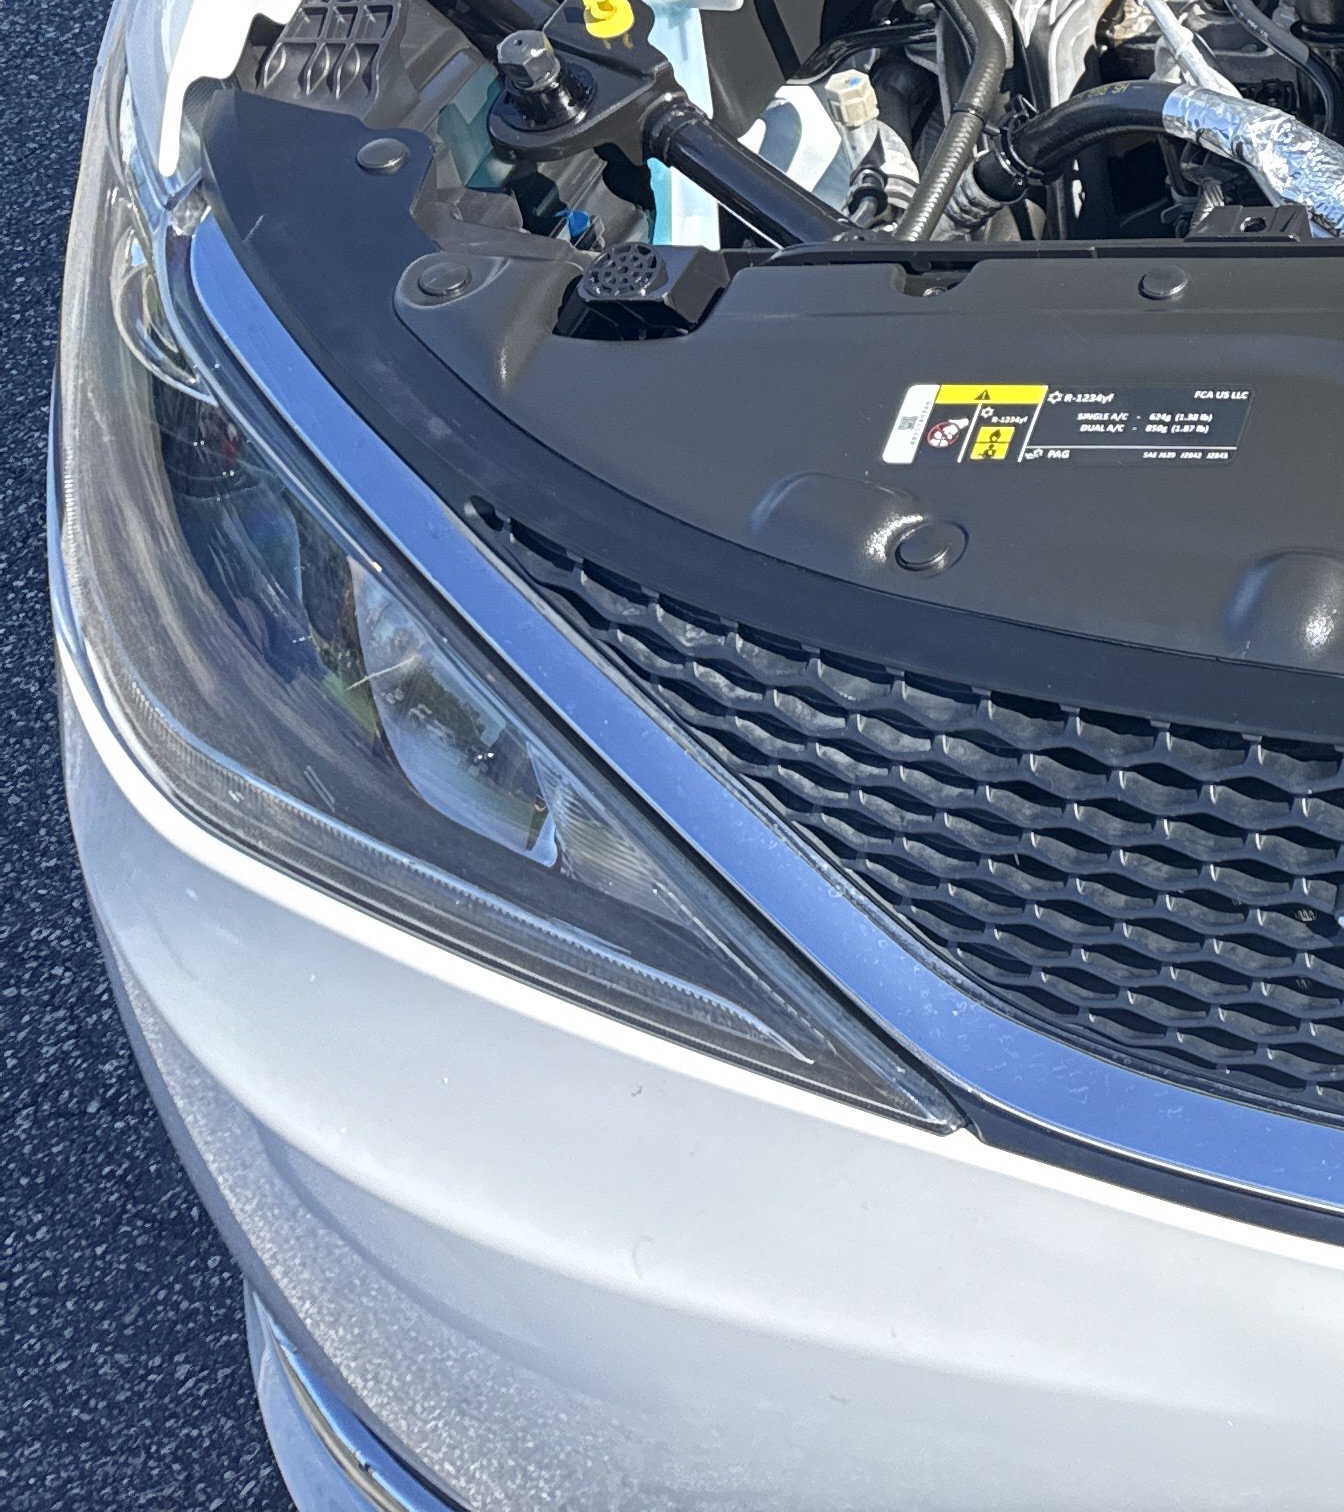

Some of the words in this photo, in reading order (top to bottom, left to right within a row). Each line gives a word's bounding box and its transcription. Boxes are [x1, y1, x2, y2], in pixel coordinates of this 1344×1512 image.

[1063, 393, 1115, 404] R-1234yf
[1194, 391, 1214, 399] FCA
[1215, 391, 1230, 399] US
[1231, 391, 1249, 400] LLC
[1077, 413, 1110, 421] SINGLE
[1110, 412, 1129, 421] A/C
[1080, 424, 1105, 432] DUAL
[1106, 424, 1125, 433] A/C
[1047, 450, 1070, 459] PAG
